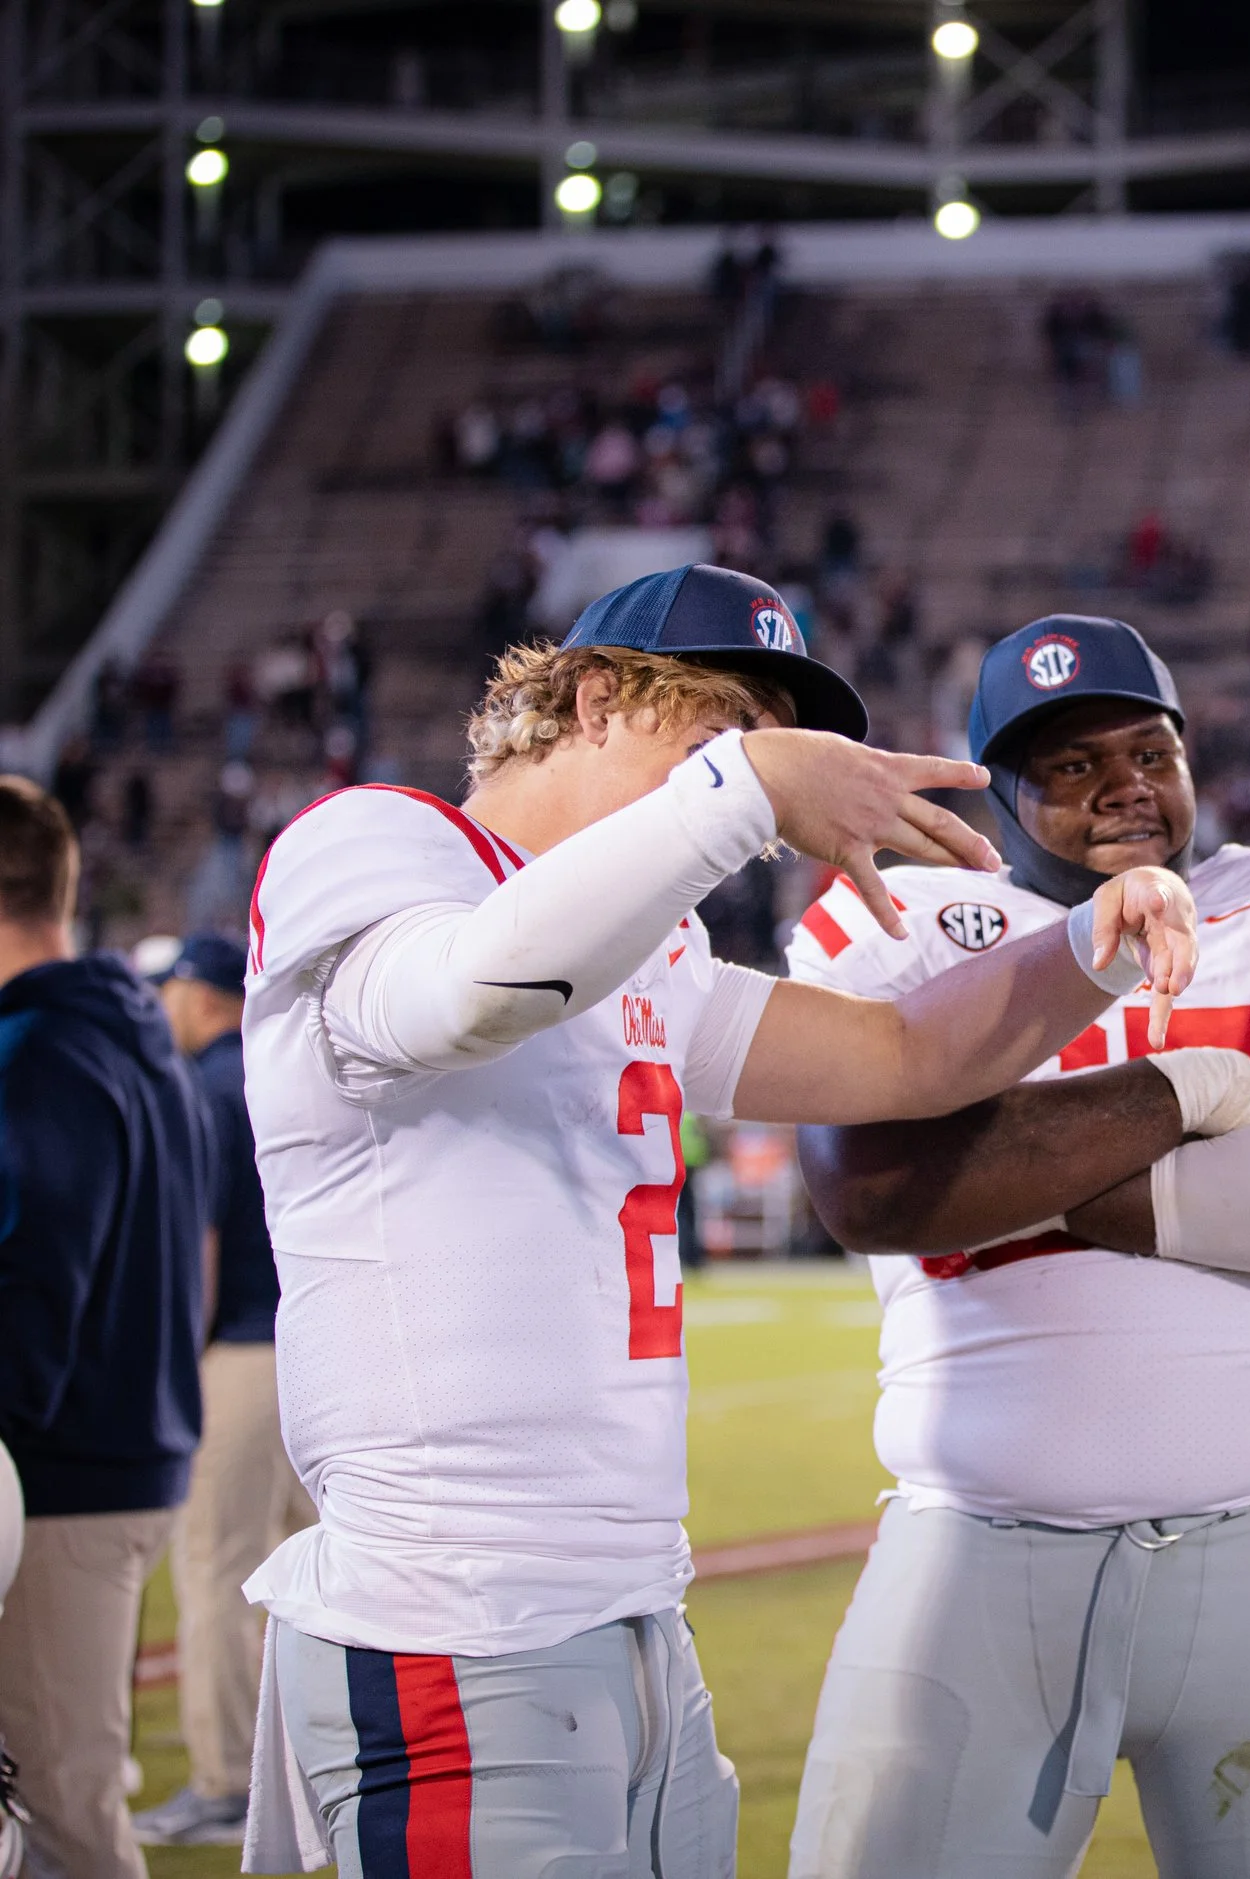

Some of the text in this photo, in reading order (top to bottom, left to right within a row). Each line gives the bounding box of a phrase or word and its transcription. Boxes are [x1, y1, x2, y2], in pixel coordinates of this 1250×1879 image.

[1030, 643, 1076, 687] SIP
[941, 903, 1004, 950] SEC
[622, 993, 667, 1048] Ole Miss
[617, 1060, 686, 1361] 2
